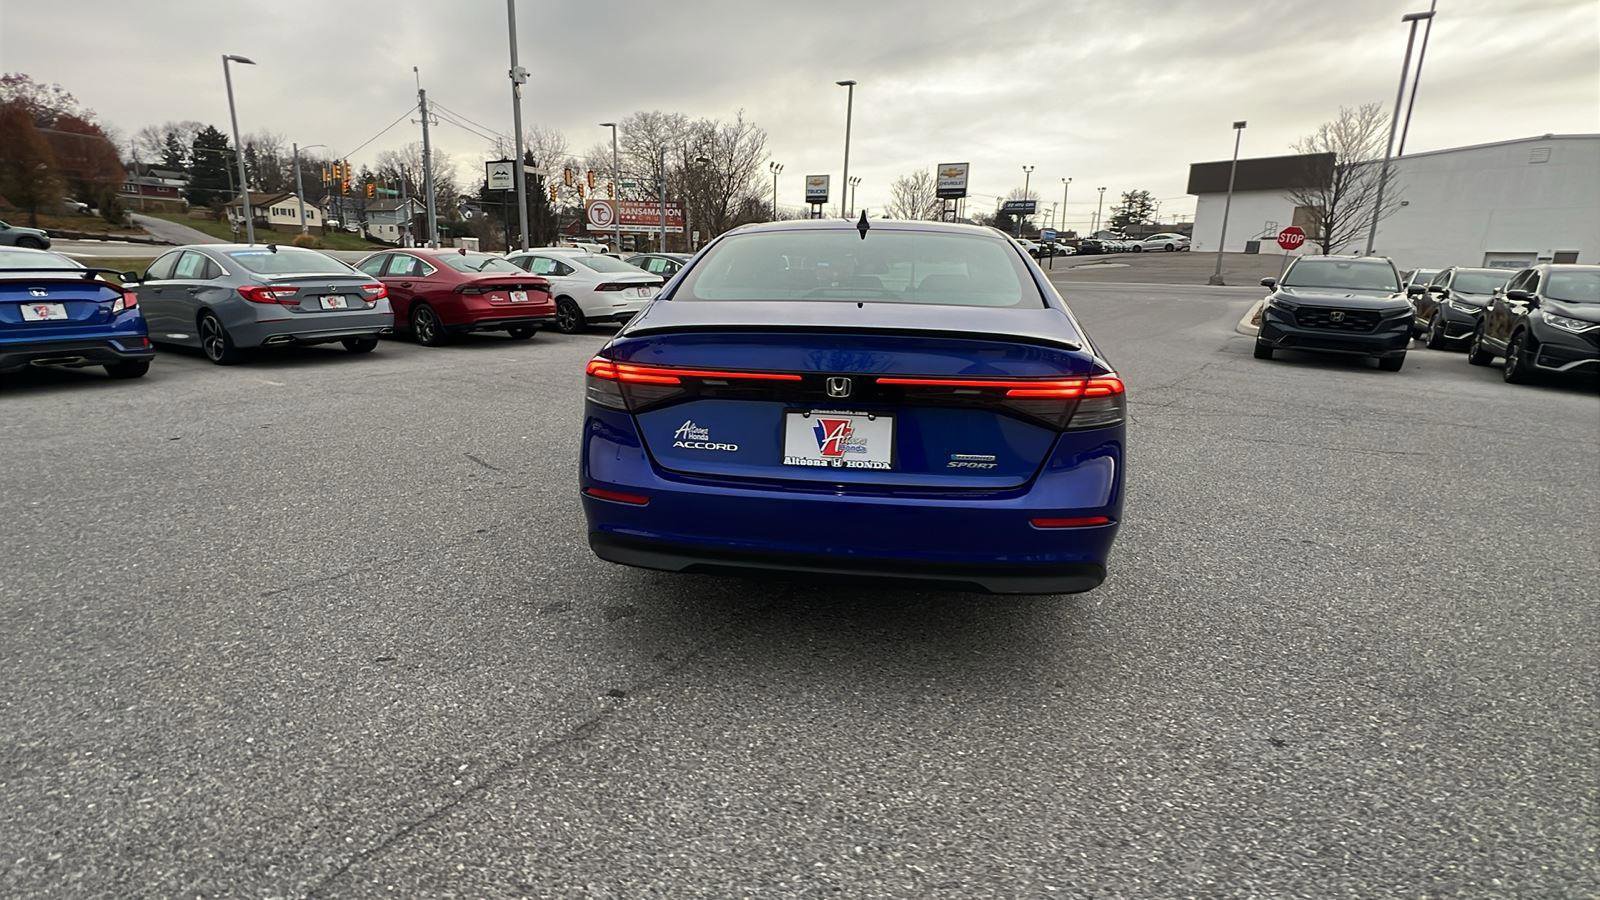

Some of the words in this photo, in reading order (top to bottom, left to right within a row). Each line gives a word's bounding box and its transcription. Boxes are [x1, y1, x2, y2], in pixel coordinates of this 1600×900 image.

[1279, 233, 1305, 244] STOP
[688, 433, 709, 441] Honda
[672, 441, 738, 451] ACCORD
[842, 445, 867, 453] Honda
[783, 456, 828, 467] Altoona
[846, 460, 892, 470] HONDA
[946, 461, 998, 469] SPORT
